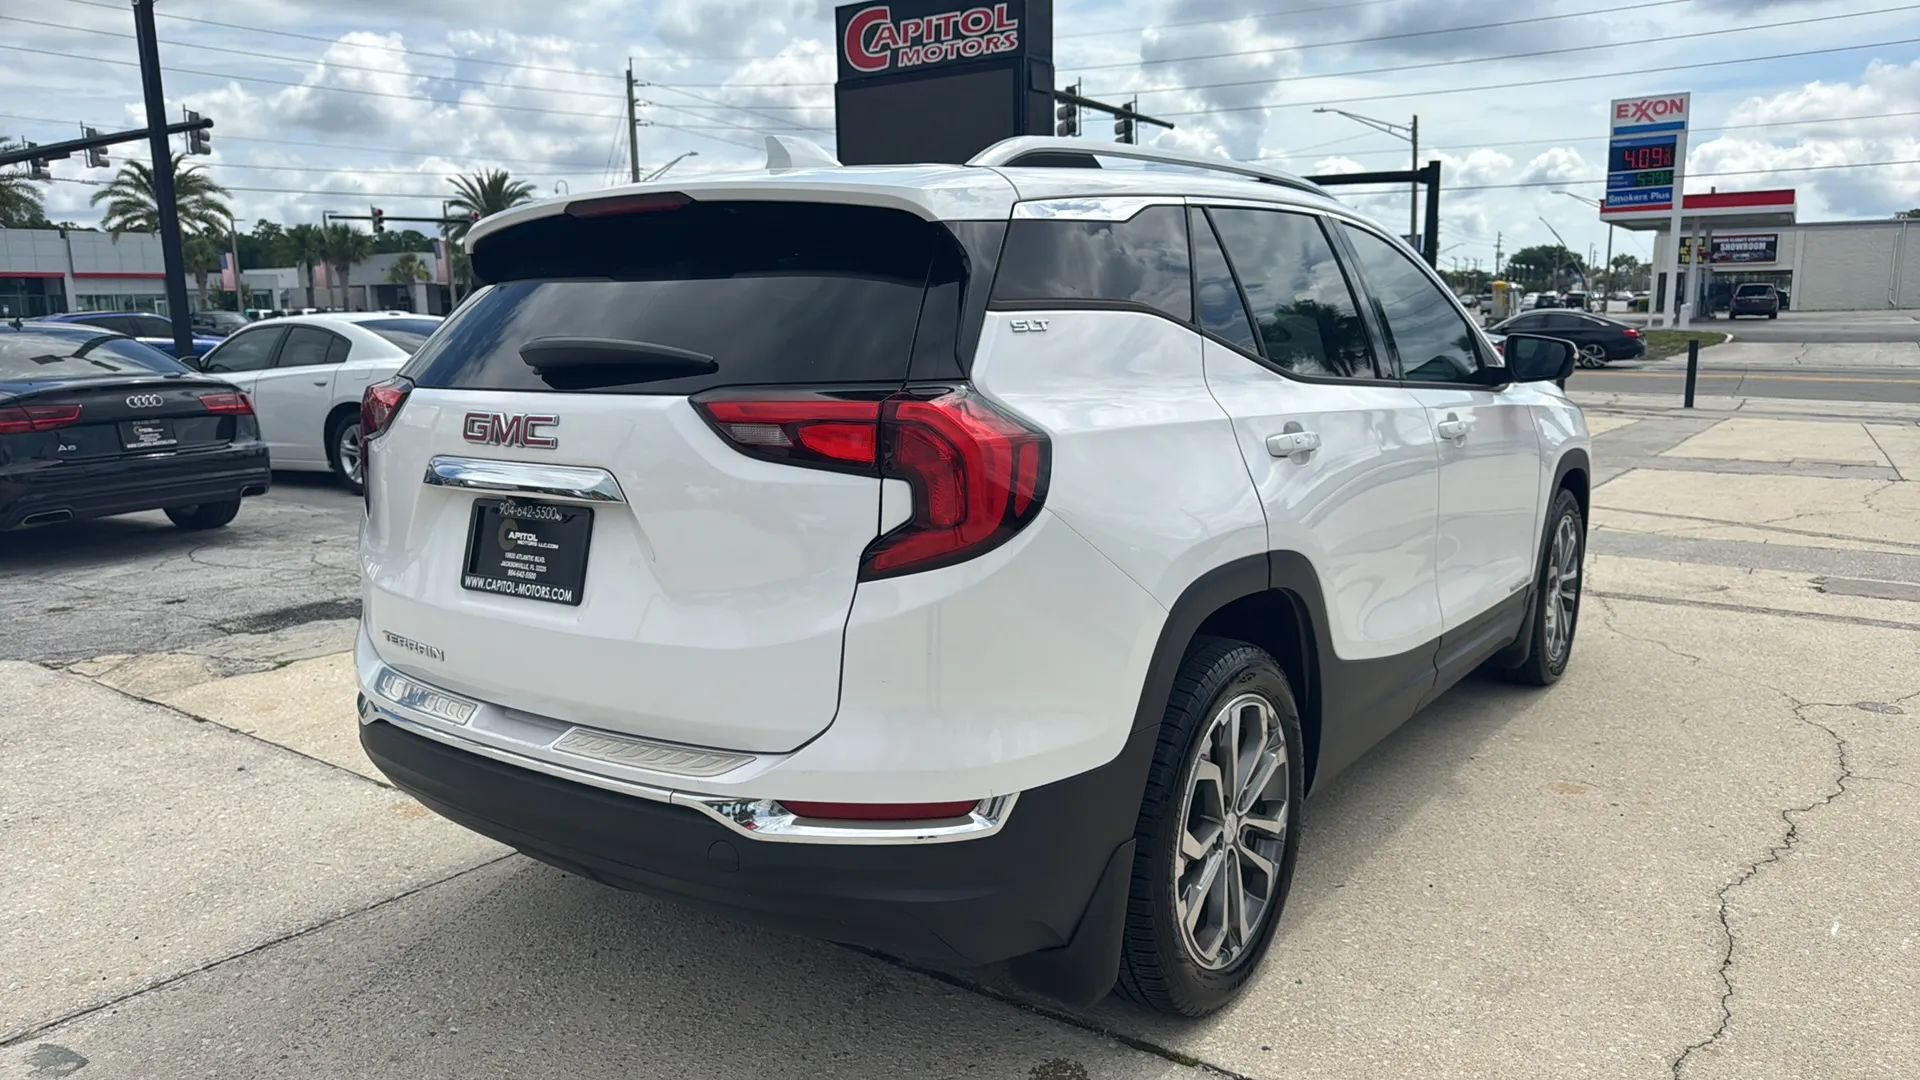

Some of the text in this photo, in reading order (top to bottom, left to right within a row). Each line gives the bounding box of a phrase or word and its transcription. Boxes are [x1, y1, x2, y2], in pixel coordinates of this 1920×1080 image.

[844, 3, 1018, 72] CAPITOL
[898, 31, 1018, 67] MOTORS
[1616, 98, 1683, 123] EXXON
[1608, 191, 1670, 204] Smokers Plus
[1720, 242, 1767, 251] SHOWROOM
[1010, 319, 1049, 333] SLT
[463, 411, 560, 449] GMC
[498, 502, 557, 520] 904-642-5500
[464, 576, 573, 602] WWW.CAPITOL-MOTORS.COM
[382, 629, 445, 662] TERRAIN
